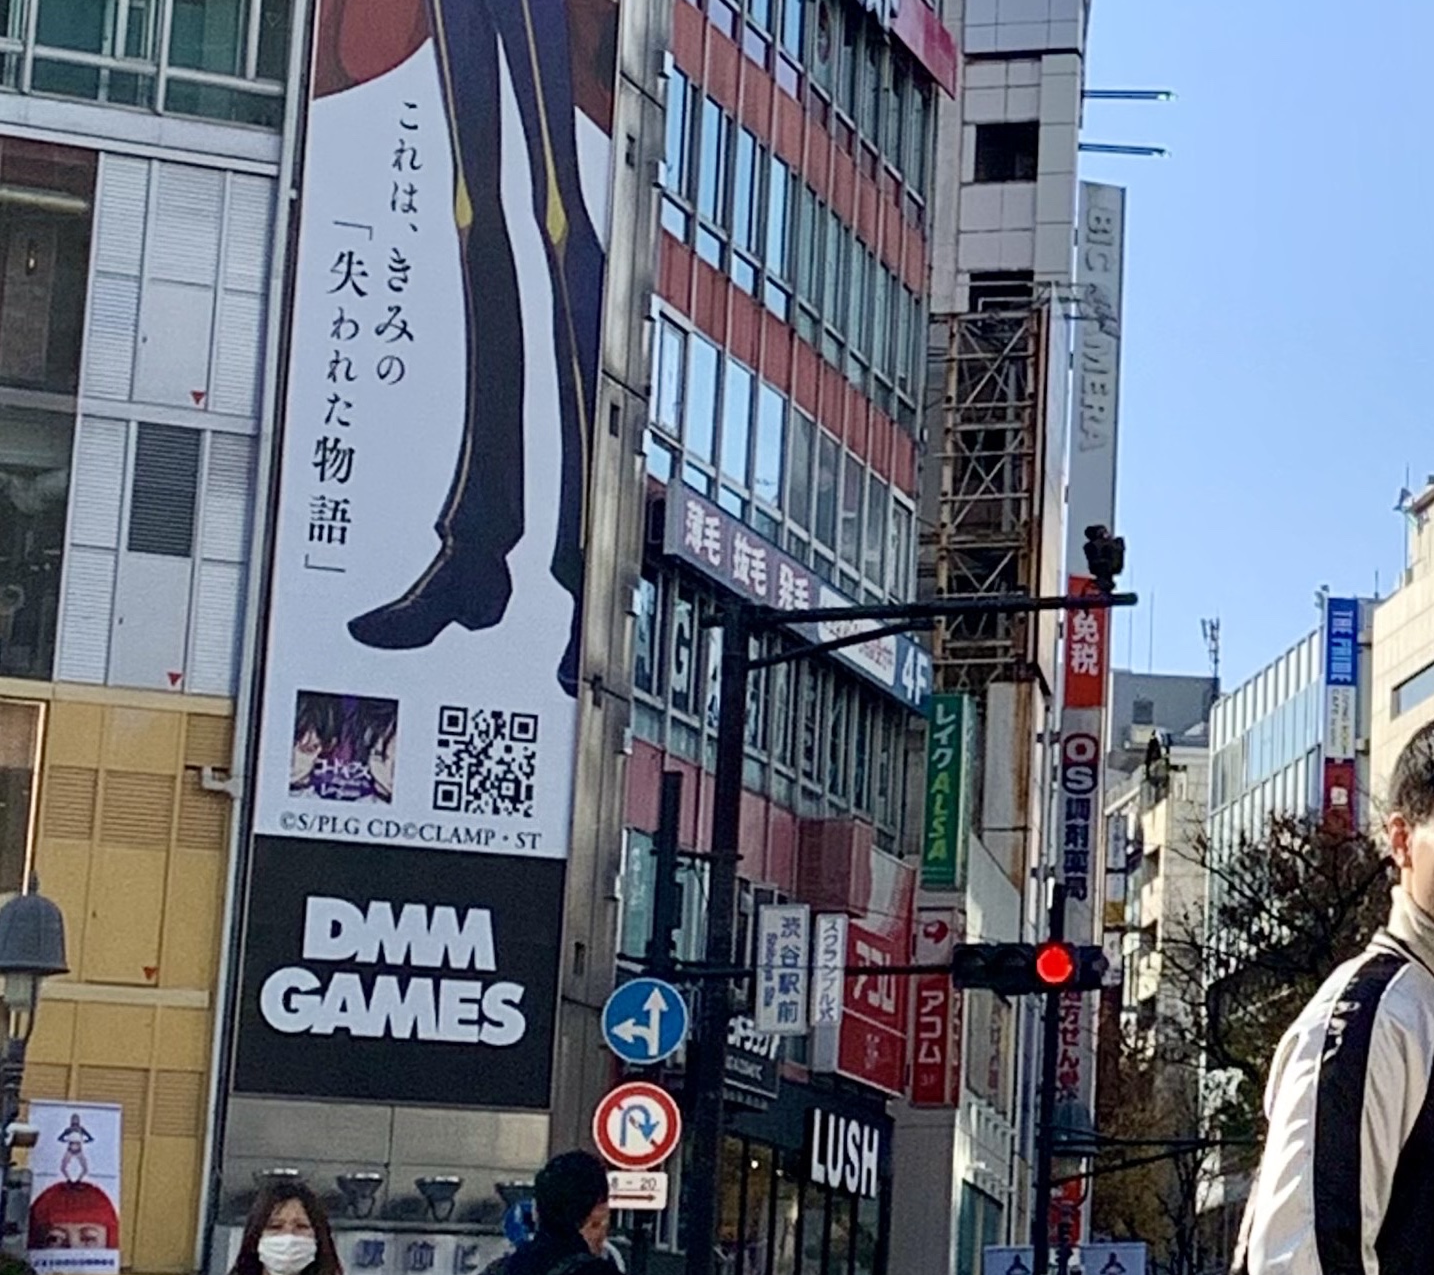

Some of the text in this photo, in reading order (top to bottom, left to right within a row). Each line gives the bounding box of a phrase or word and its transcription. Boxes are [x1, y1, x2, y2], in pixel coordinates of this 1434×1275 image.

[375, 100, 423, 386] これは、きみの
[303, 220, 373, 573] 「失われた物語」
[902, 645, 930, 705] 4F
[1069, 612, 1099, 676] 免税
[302, 896, 497, 971] DMM
[777, 916, 801, 1024] 渋谷駅前
[260, 966, 526, 1046] GAMES
[918, 989, 945, 1064] アコム
[640, 1177, 657, 1191] 20
[811, 1108, 879, 1198] LUSH
